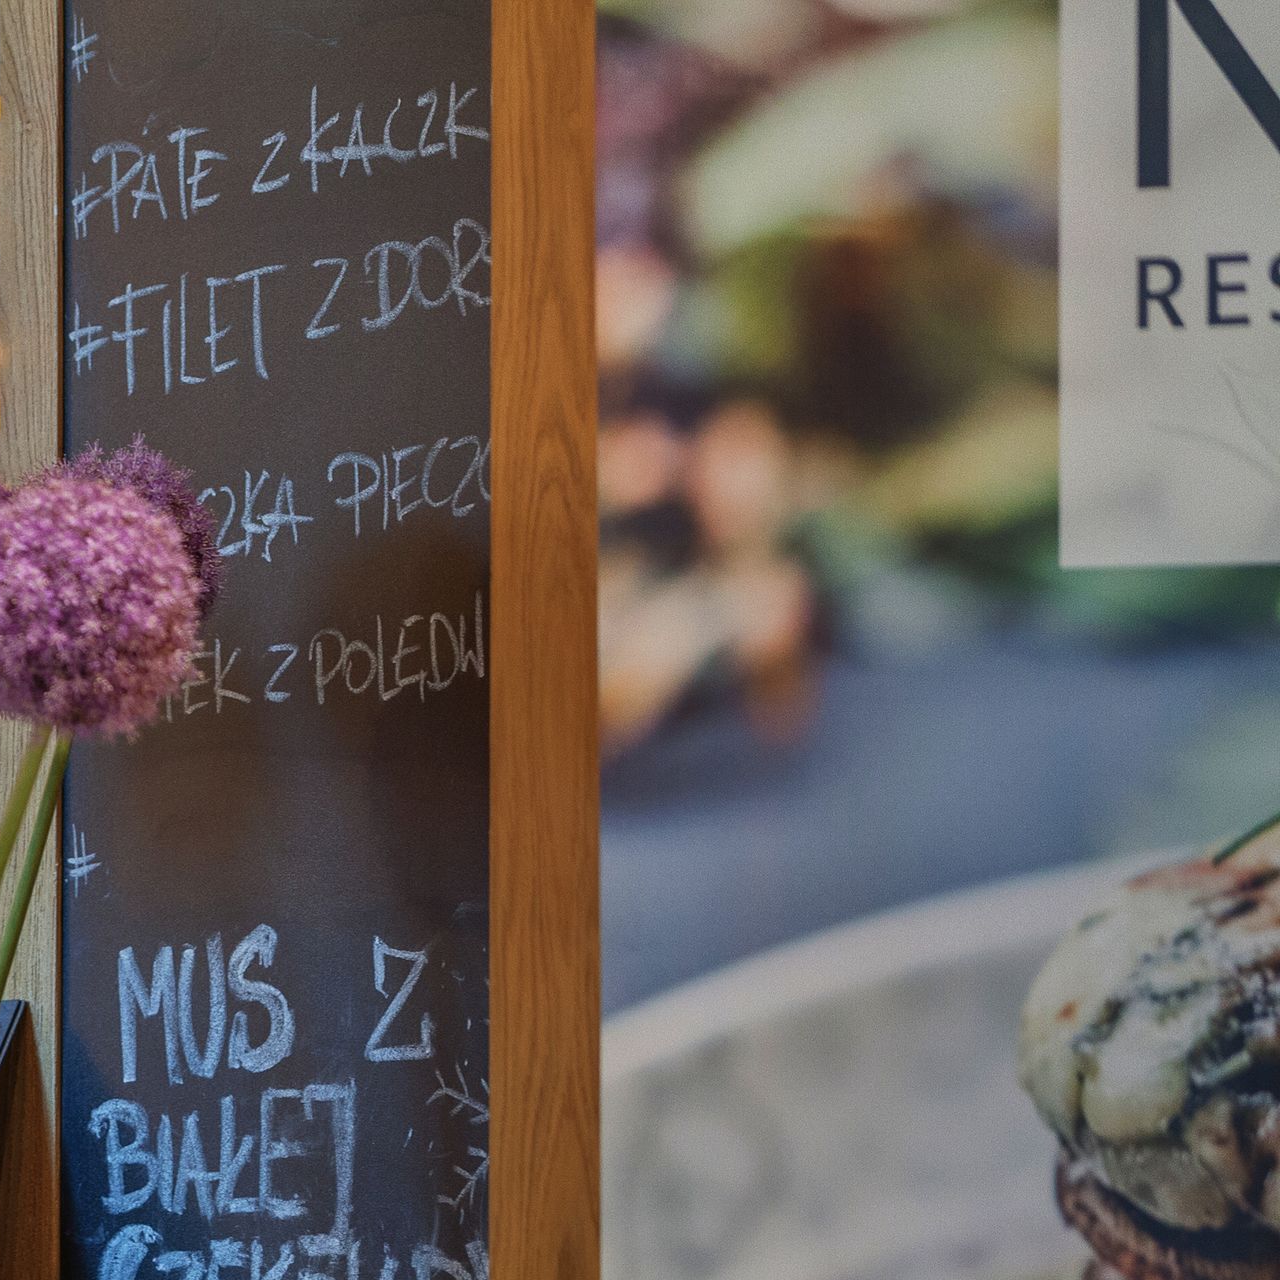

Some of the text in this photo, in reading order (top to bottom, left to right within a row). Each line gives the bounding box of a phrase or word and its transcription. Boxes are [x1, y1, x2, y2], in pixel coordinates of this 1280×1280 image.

[360, 217, 491, 331] DOR
[118, 923, 435, 1086] MUS Z
